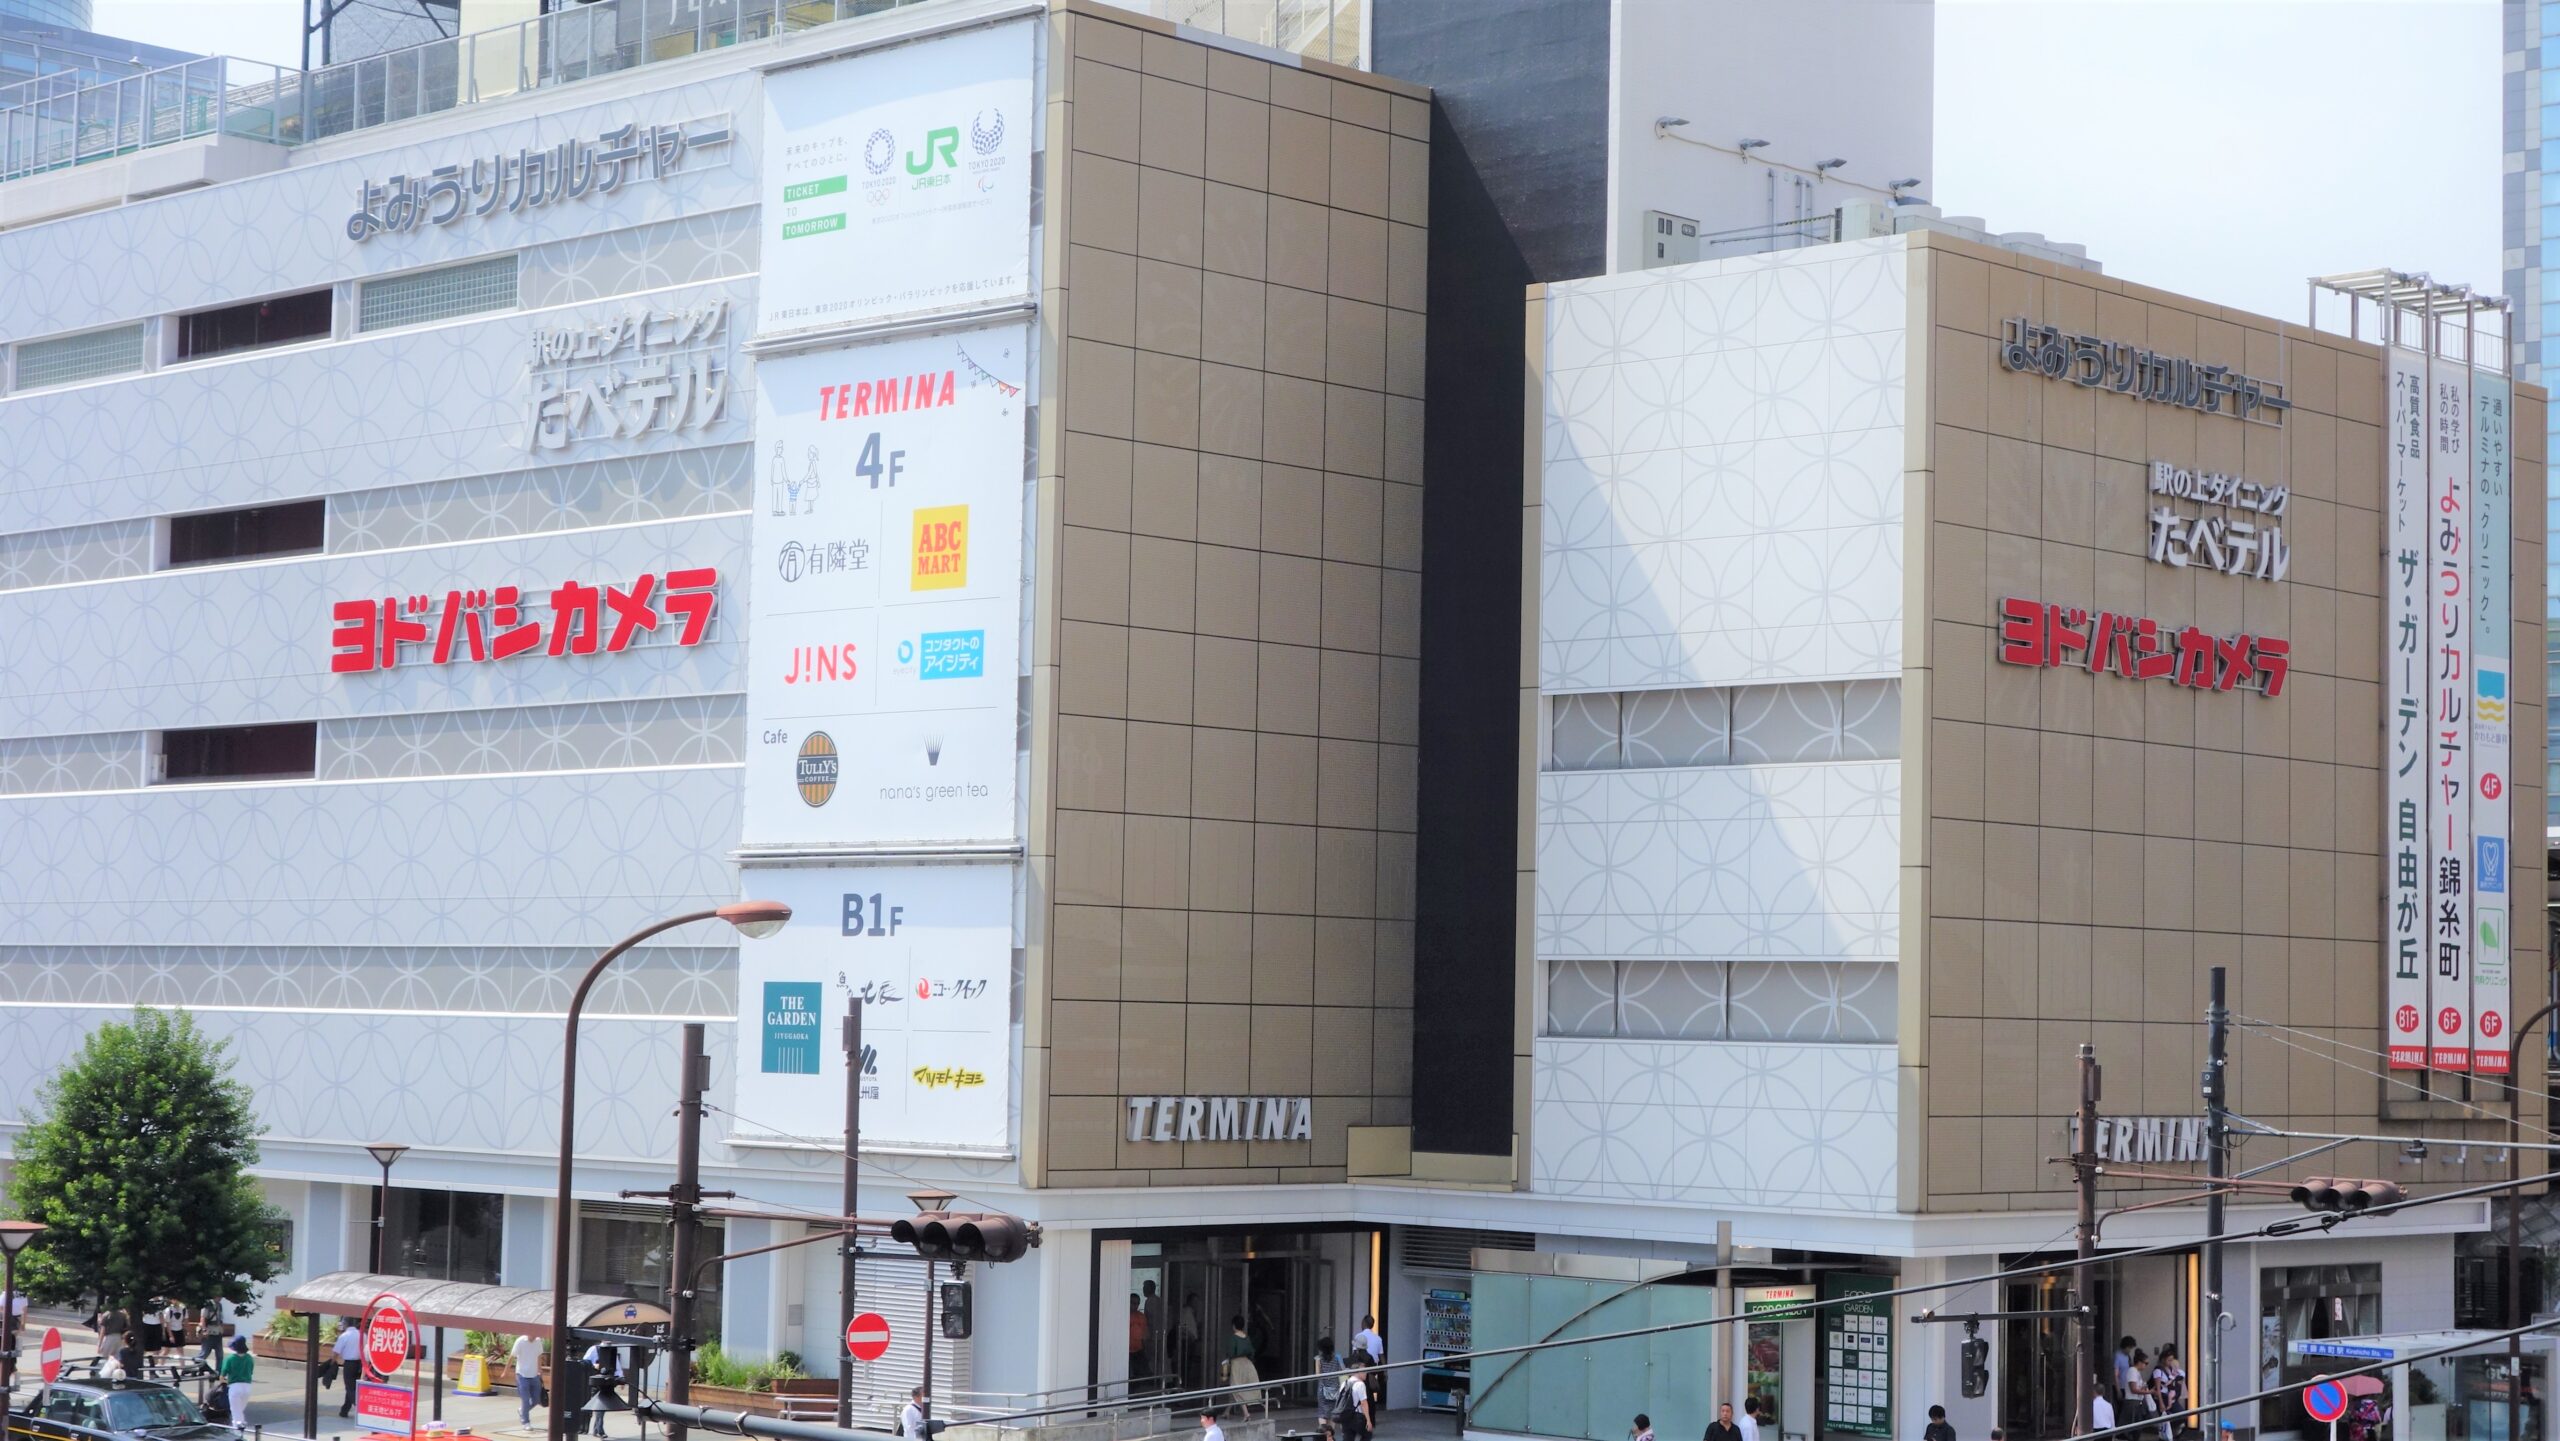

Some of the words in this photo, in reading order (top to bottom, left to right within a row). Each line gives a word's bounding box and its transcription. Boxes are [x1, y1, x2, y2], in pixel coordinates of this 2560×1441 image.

[905, 125, 960, 175] JR
[968, 159, 988, 171] TOKYO
[988, 156, 1006, 167] 2020
[346, 123, 735, 243] よみうりカルチャー
[786, 183, 820, 200] TICKET
[861, 178, 881, 190] TOKYO
[882, 176, 897, 187] 2020
[911, 174, 952, 191] JR東日本
[786, 207, 798, 218] TO
[785, 217, 838, 237] TOMORROW
[528, 298, 729, 369] 駅の上ダイニング
[2006, 315, 2291, 421] よみうりカルチャー
[522, 353, 729, 454] たべテル
[819, 370, 955, 421] TERMINA
[2409, 374, 2420, 460] 高質食品
[2439, 383, 2449, 454] 私の時間
[2450, 385, 2460, 453] 私の学び
[2396, 371, 2408, 532] スーパーマーケット
[2492, 398, 2503, 496] 通いやすい
[855, 432, 906, 489] 4F
[2152, 461, 2289, 516] 駅の上ダイニング
[918, 520, 962, 553] ABC
[2150, 506, 2290, 583] たべテル
[806, 538, 869, 575] 有隣堂
[917, 553, 961, 576] MART
[331, 567, 719, 674] ヨドバシカメラ
[925, 636, 980, 652] コンタクトの
[2002, 597, 2290, 697] ヨドバシカメラ
[924, 653, 980, 673] アイシティ
[763, 729, 788, 745] Cafe
[804, 775, 830, 783] COFFEE
[2483, 777, 2498, 796] 4F
[879, 786, 921, 800] nana's
[925, 785, 963, 802] green
[967, 783, 988, 798] tea
[842, 893, 904, 937] B1F
[780, 996, 805, 1010] THE
[767, 1011, 817, 1026] GARDEN
[2399, 1009, 2418, 1029] B1F
[2443, 1012, 2458, 1030] 6F
[2484, 1015, 2499, 1034] 6F
[2391, 1050, 2424, 1063] TERMINA
[2434, 1052, 2467, 1065] TERMINA
[2476, 1055, 2507, 1068] TERMINA
[913, 1066, 986, 1090] マツモトキヨシ
[859, 1086, 880, 1100] 州屋
[1127, 1097, 1313, 1143] TERMINA
[1765, 1289, 1795, 1299] TERMINA
[1843, 1303, 1874, 1314] GARDEN
[371, 1327, 405, 1355] 消火栓
